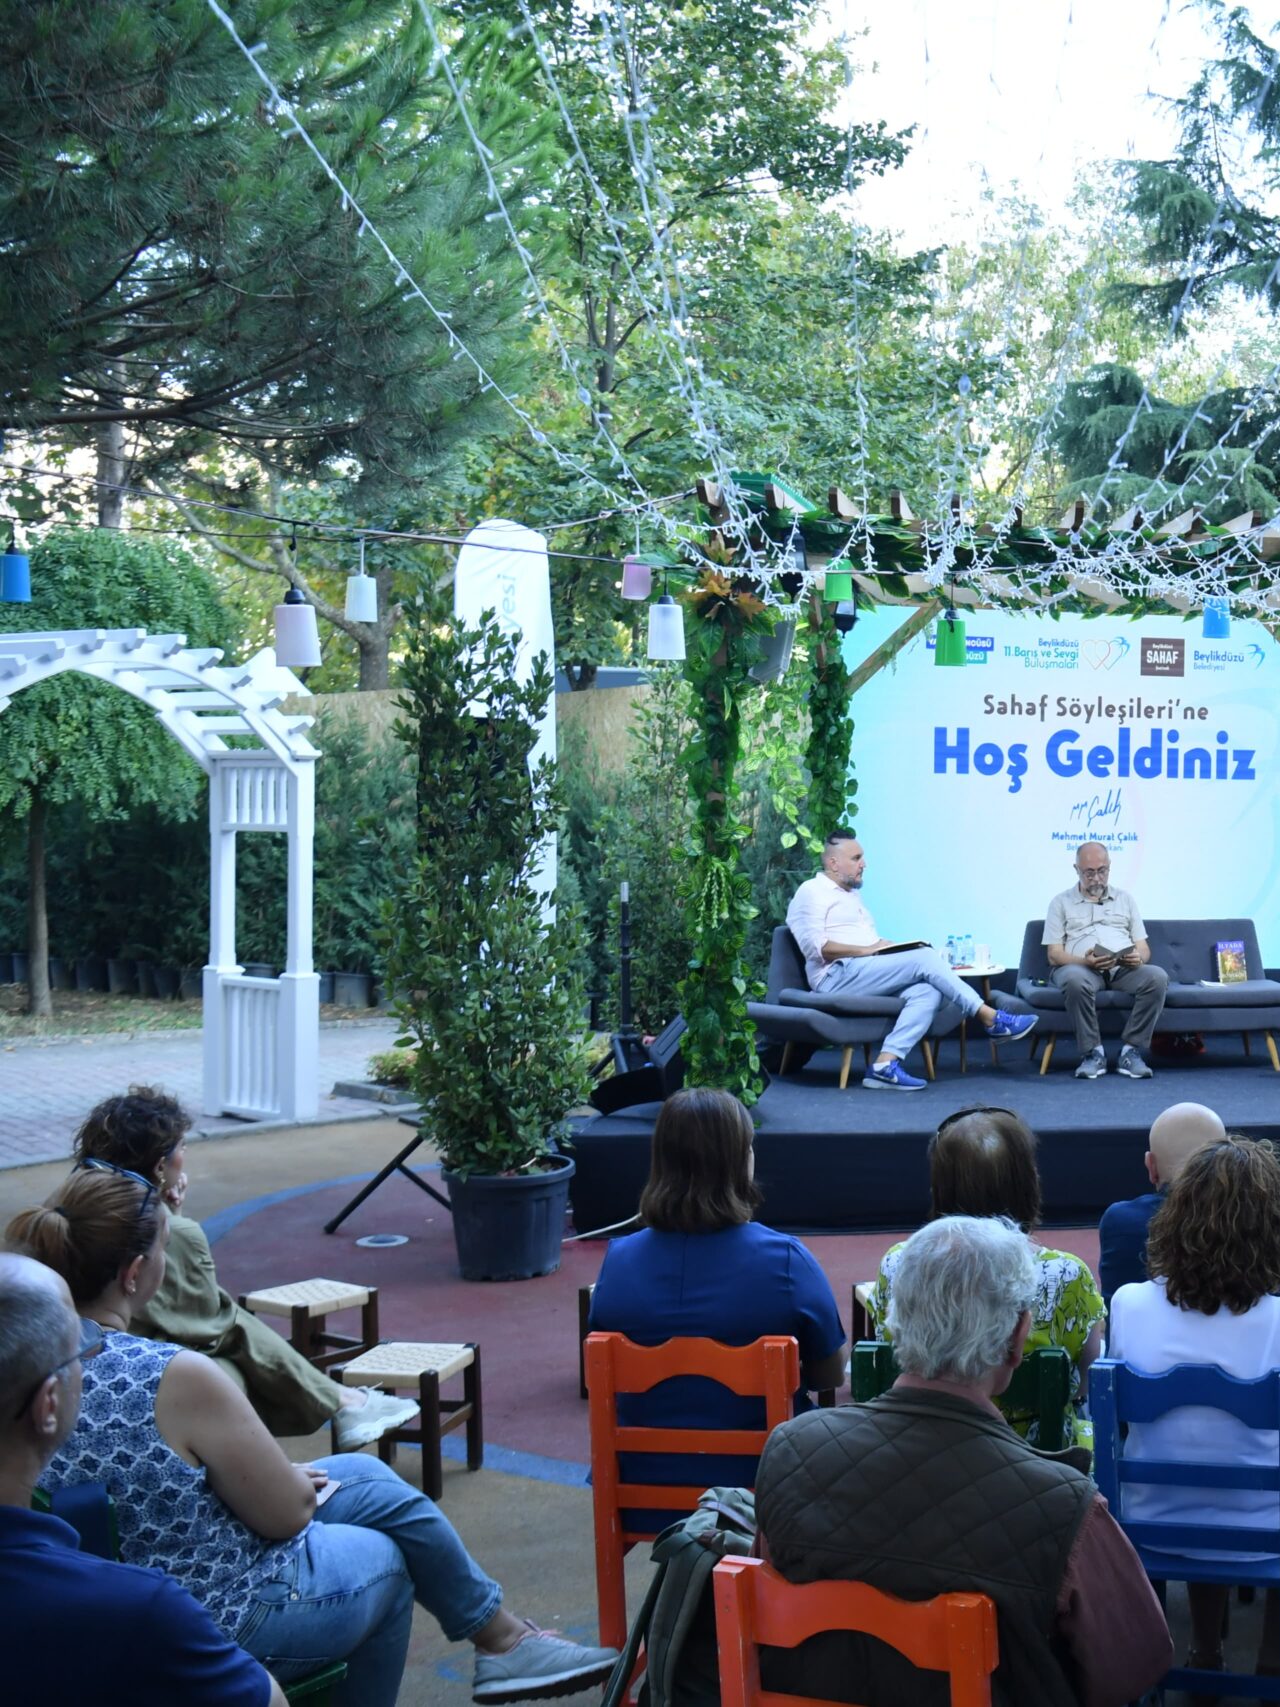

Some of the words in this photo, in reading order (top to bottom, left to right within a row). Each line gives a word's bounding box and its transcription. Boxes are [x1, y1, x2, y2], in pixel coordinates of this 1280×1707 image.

[1038, 637, 1079, 648] Beylikdüzü
[1041, 650, 1052, 658] ve
[1054, 647, 1079, 661] Sevgi
[1146, 650, 1179, 665] SAHAF
[1193, 650, 1245, 663] Beylikdüzü
[1025, 657, 1079, 669] Buluşmaları
[1193, 662, 1226, 672] Belediyesi
[983, 694, 1048, 722] Sahaf
[1056, 696, 1209, 725] Söyleşileri'ne
[934, 727, 1028, 794] Hoş
[1045, 727, 1256, 780] Geldiniz
[1052, 832, 1087, 841] Mehmet
[1089, 832, 1115, 841] Murat
[1117, 832, 1138, 844] Çalık
